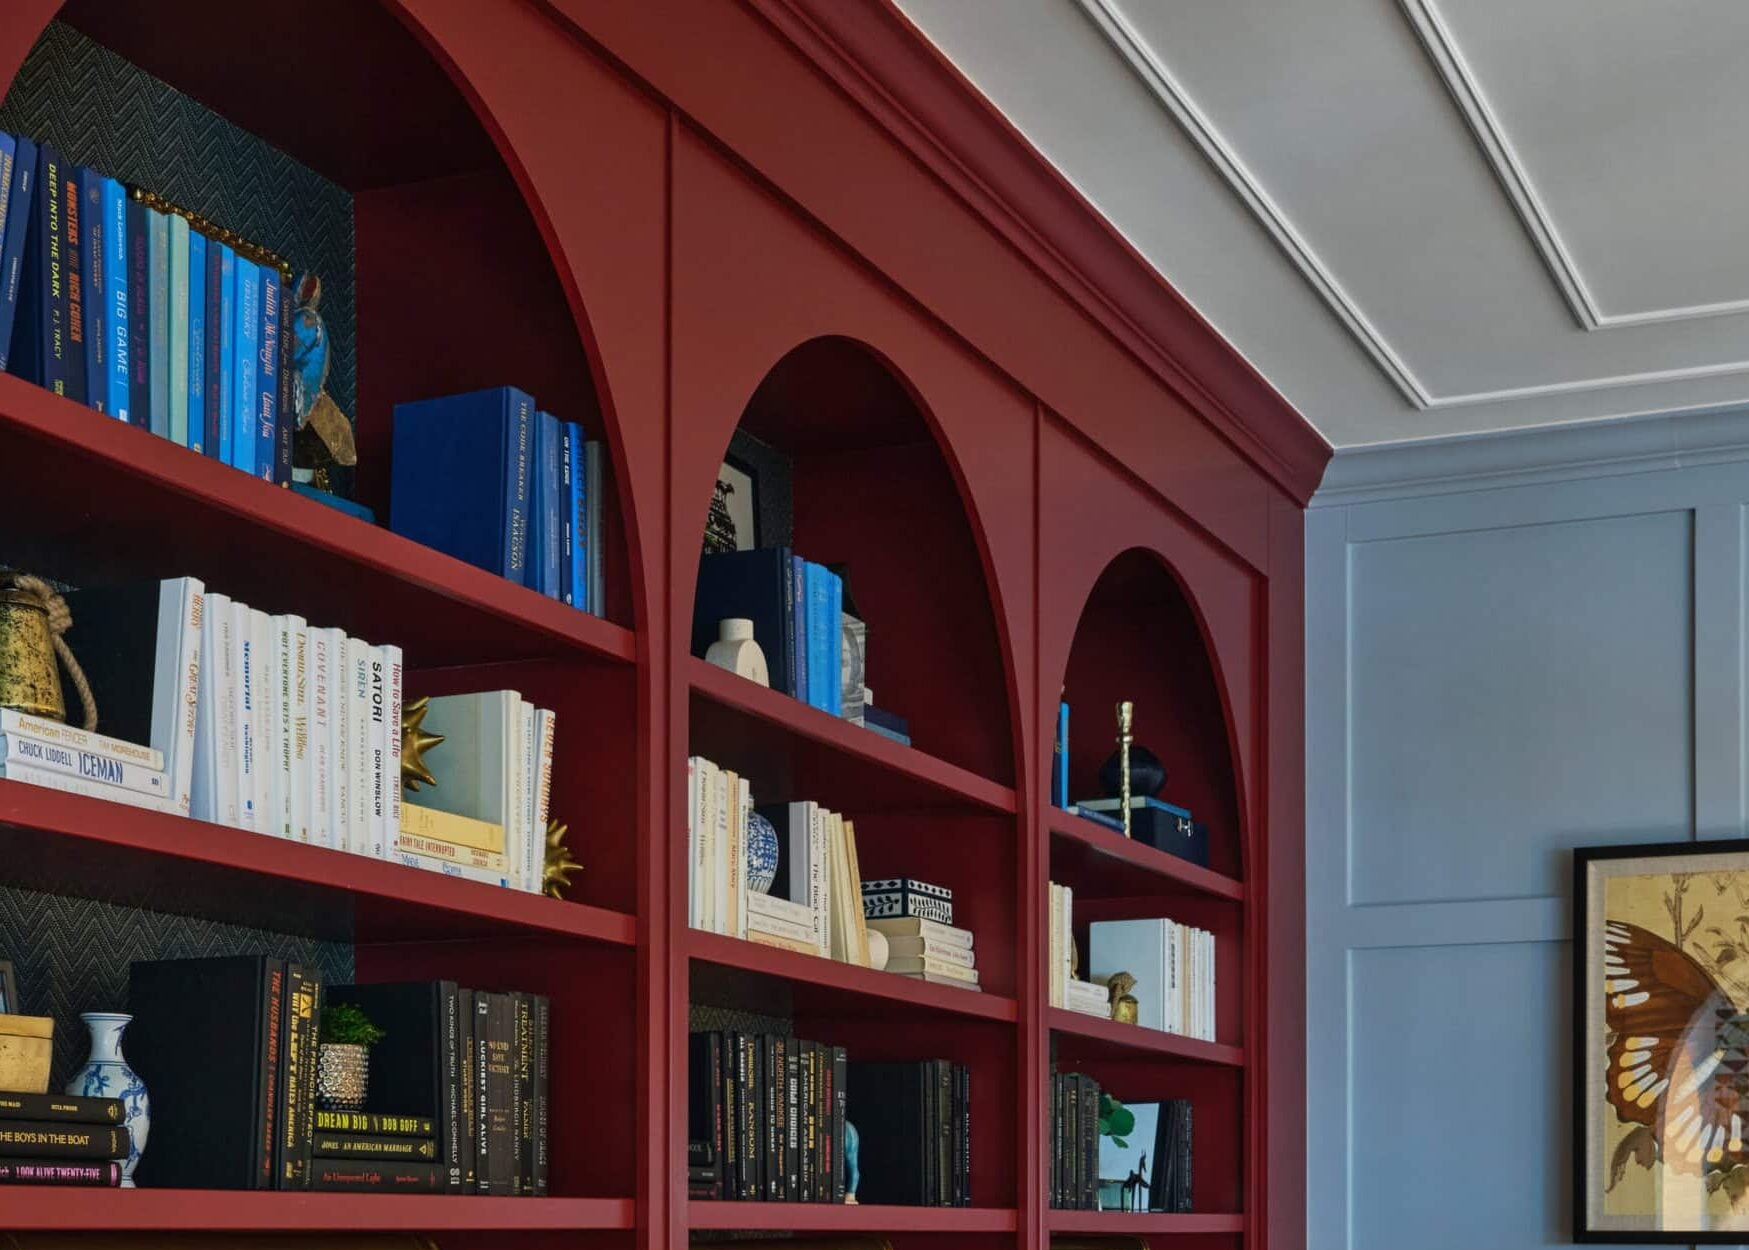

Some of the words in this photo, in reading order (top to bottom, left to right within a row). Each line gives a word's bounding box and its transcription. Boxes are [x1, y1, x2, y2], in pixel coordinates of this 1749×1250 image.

[48, 163, 57, 196] DEEP
[50, 200, 58, 229] INTO
[67, 181, 78, 244] MONSTERS
[51, 262, 60, 298] DARK
[70, 272, 80, 300] RICH
[116, 290, 127, 319] BIG
[265, 279, 276, 316] Judith
[70, 302, 82, 342] COHEN
[53, 328, 62, 360] TRACY
[117, 325, 127, 374] GAME
[260, 319, 276, 376] McNaught
[262, 392, 273, 417] Until
[520, 402, 528, 421] THE
[260, 416, 275, 439] You
[511, 508, 520, 570] ISAACSON
[281, 631, 289, 648] NOT
[243, 640, 251, 711] Memorial
[317, 641, 326, 728] COVENANT
[356, 658, 366, 699] SIREN
[392, 664, 401, 685] How
[372, 662, 382, 723] SATORI
[392, 688, 400, 700] to
[19, 717, 60, 738] American
[392, 702, 401, 727] Save
[391, 738, 401, 758] Life
[544, 716, 555, 758] SEVEN
[19, 740, 42, 760] CHUCK
[46, 746, 72, 766] LIDDELL
[78, 752, 123, 784] ICEMAN
[271, 971, 281, 997] THE
[267, 998, 280, 1063] HUSBANDS
[310, 1025, 318, 1047] THE
[520, 1001, 529, 1082] TREATMENT
[777, 1056, 785, 1089] NORTH
[288, 1075, 297, 1105] HATES
[306, 1103, 315, 1146] EFFECT
[317, 1112, 350, 1129] DREAM
[352, 1114, 369, 1131] BIG
[399, 1119, 419, 1132] GOFF
[777, 1093, 785, 1128] YANKEE
[14, 1132, 36, 1142] BOYS
[38, 1134, 47, 1142] IN
[49, 1134, 67, 1144] THE
[68, 1136, 90, 1145] BOAT
[286, 1108, 296, 1148] AMERICA
[747, 1102, 755, 1159] RANSOM
